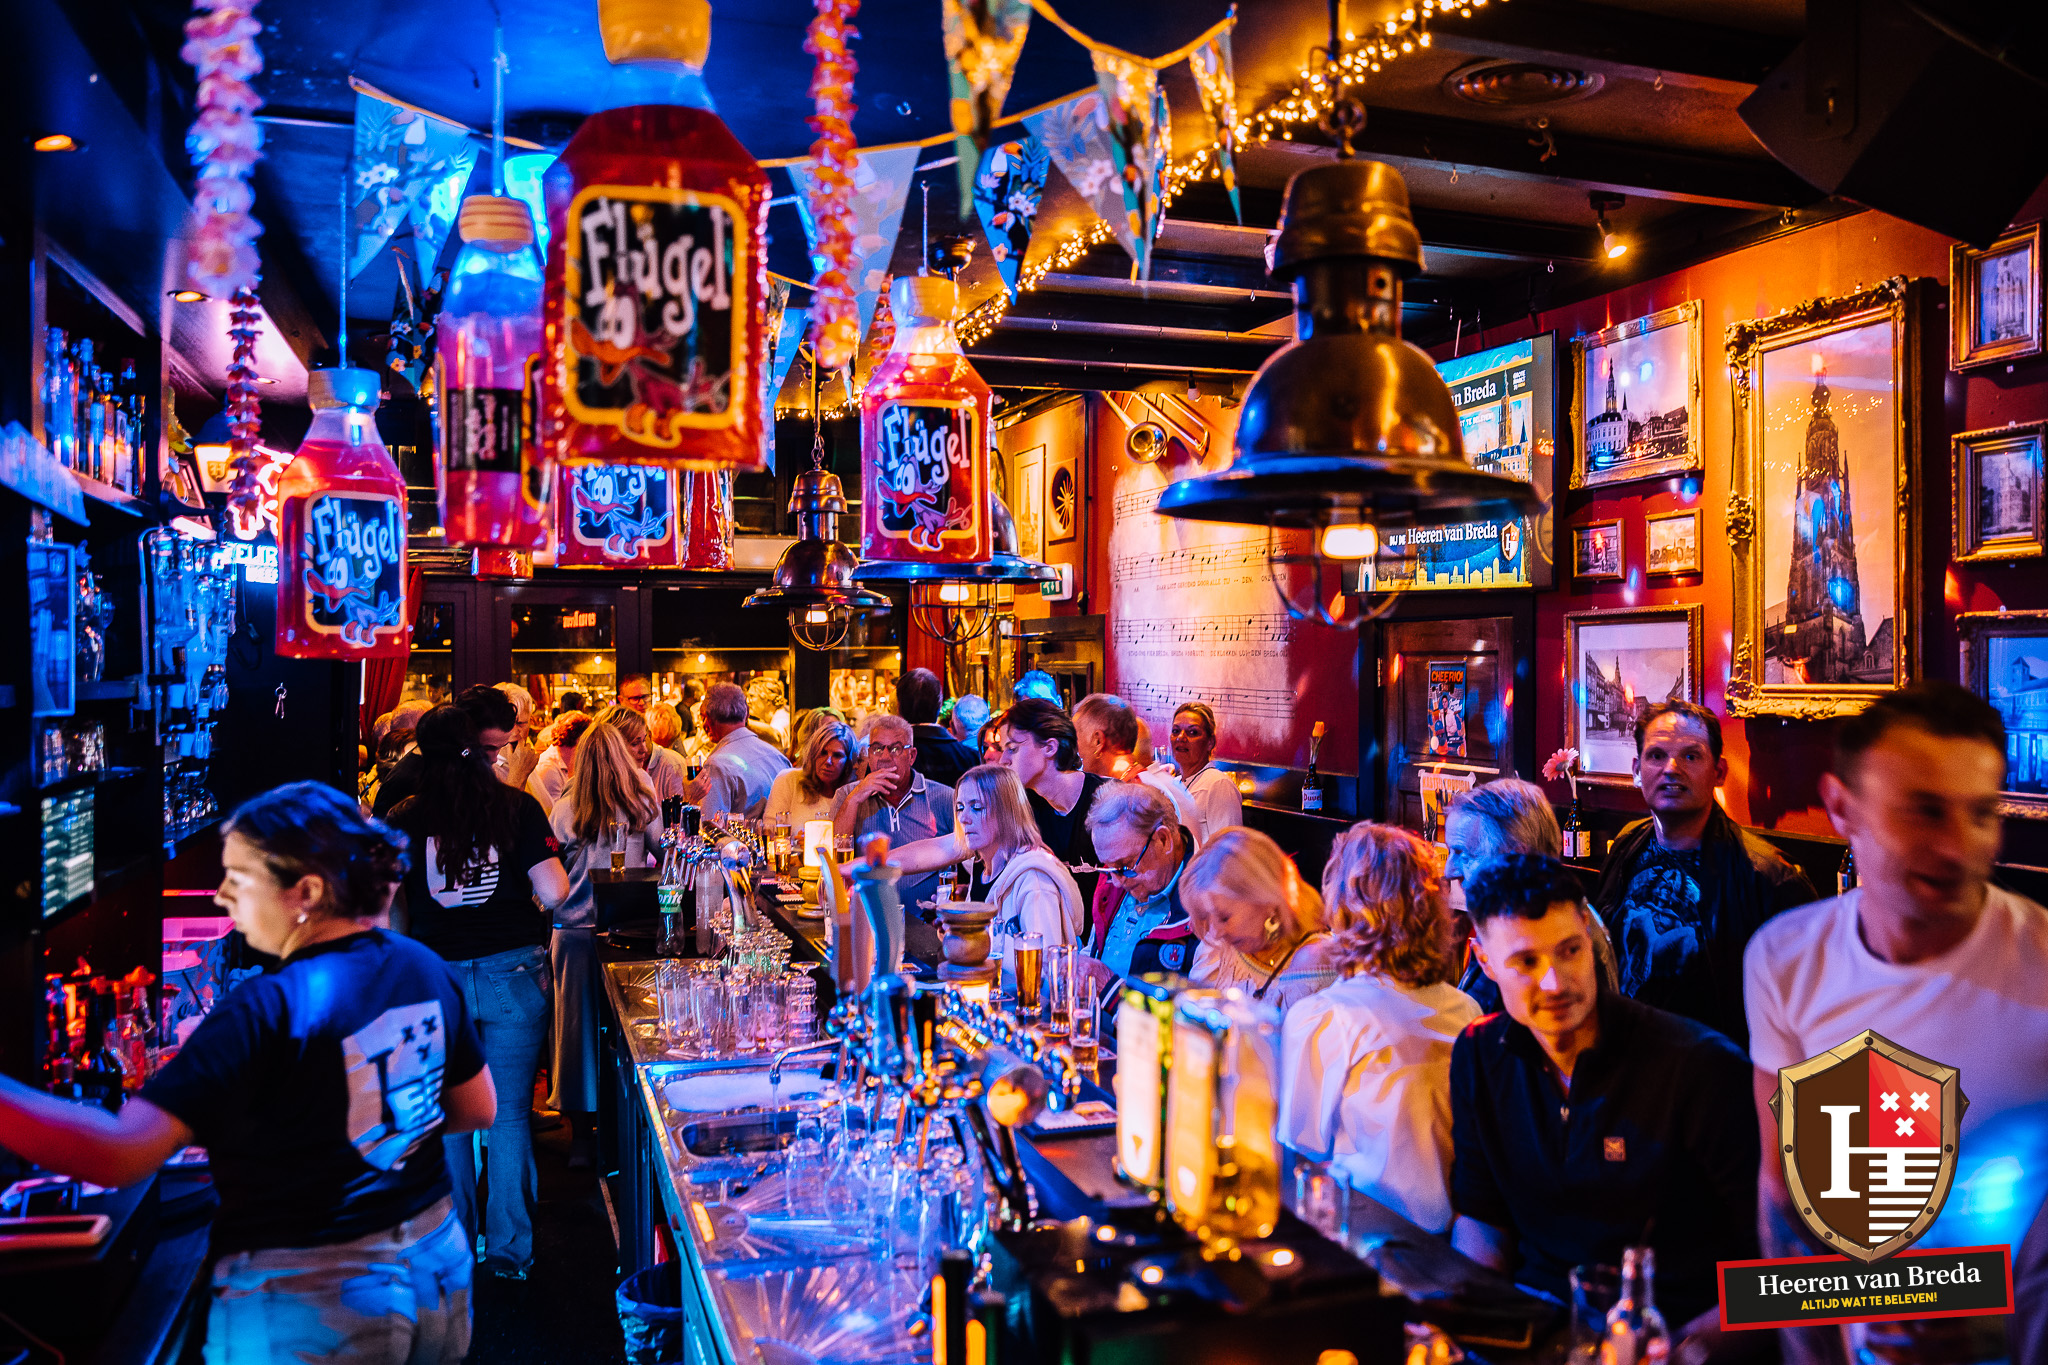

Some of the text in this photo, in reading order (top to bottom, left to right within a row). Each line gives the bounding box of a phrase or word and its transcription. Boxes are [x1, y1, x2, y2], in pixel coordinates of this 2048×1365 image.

[582, 195, 731, 336] Flügel
[1463, 379, 1497, 405] Breda
[884, 403, 971, 486] Flügel
[312, 494, 400, 580] Flügel
[1407, 528, 1443, 545] Heeren
[1444, 528, 1464, 543] van
[1465, 520, 1498, 540] Breda
[1431, 670, 1464, 682] CHEERIO!
